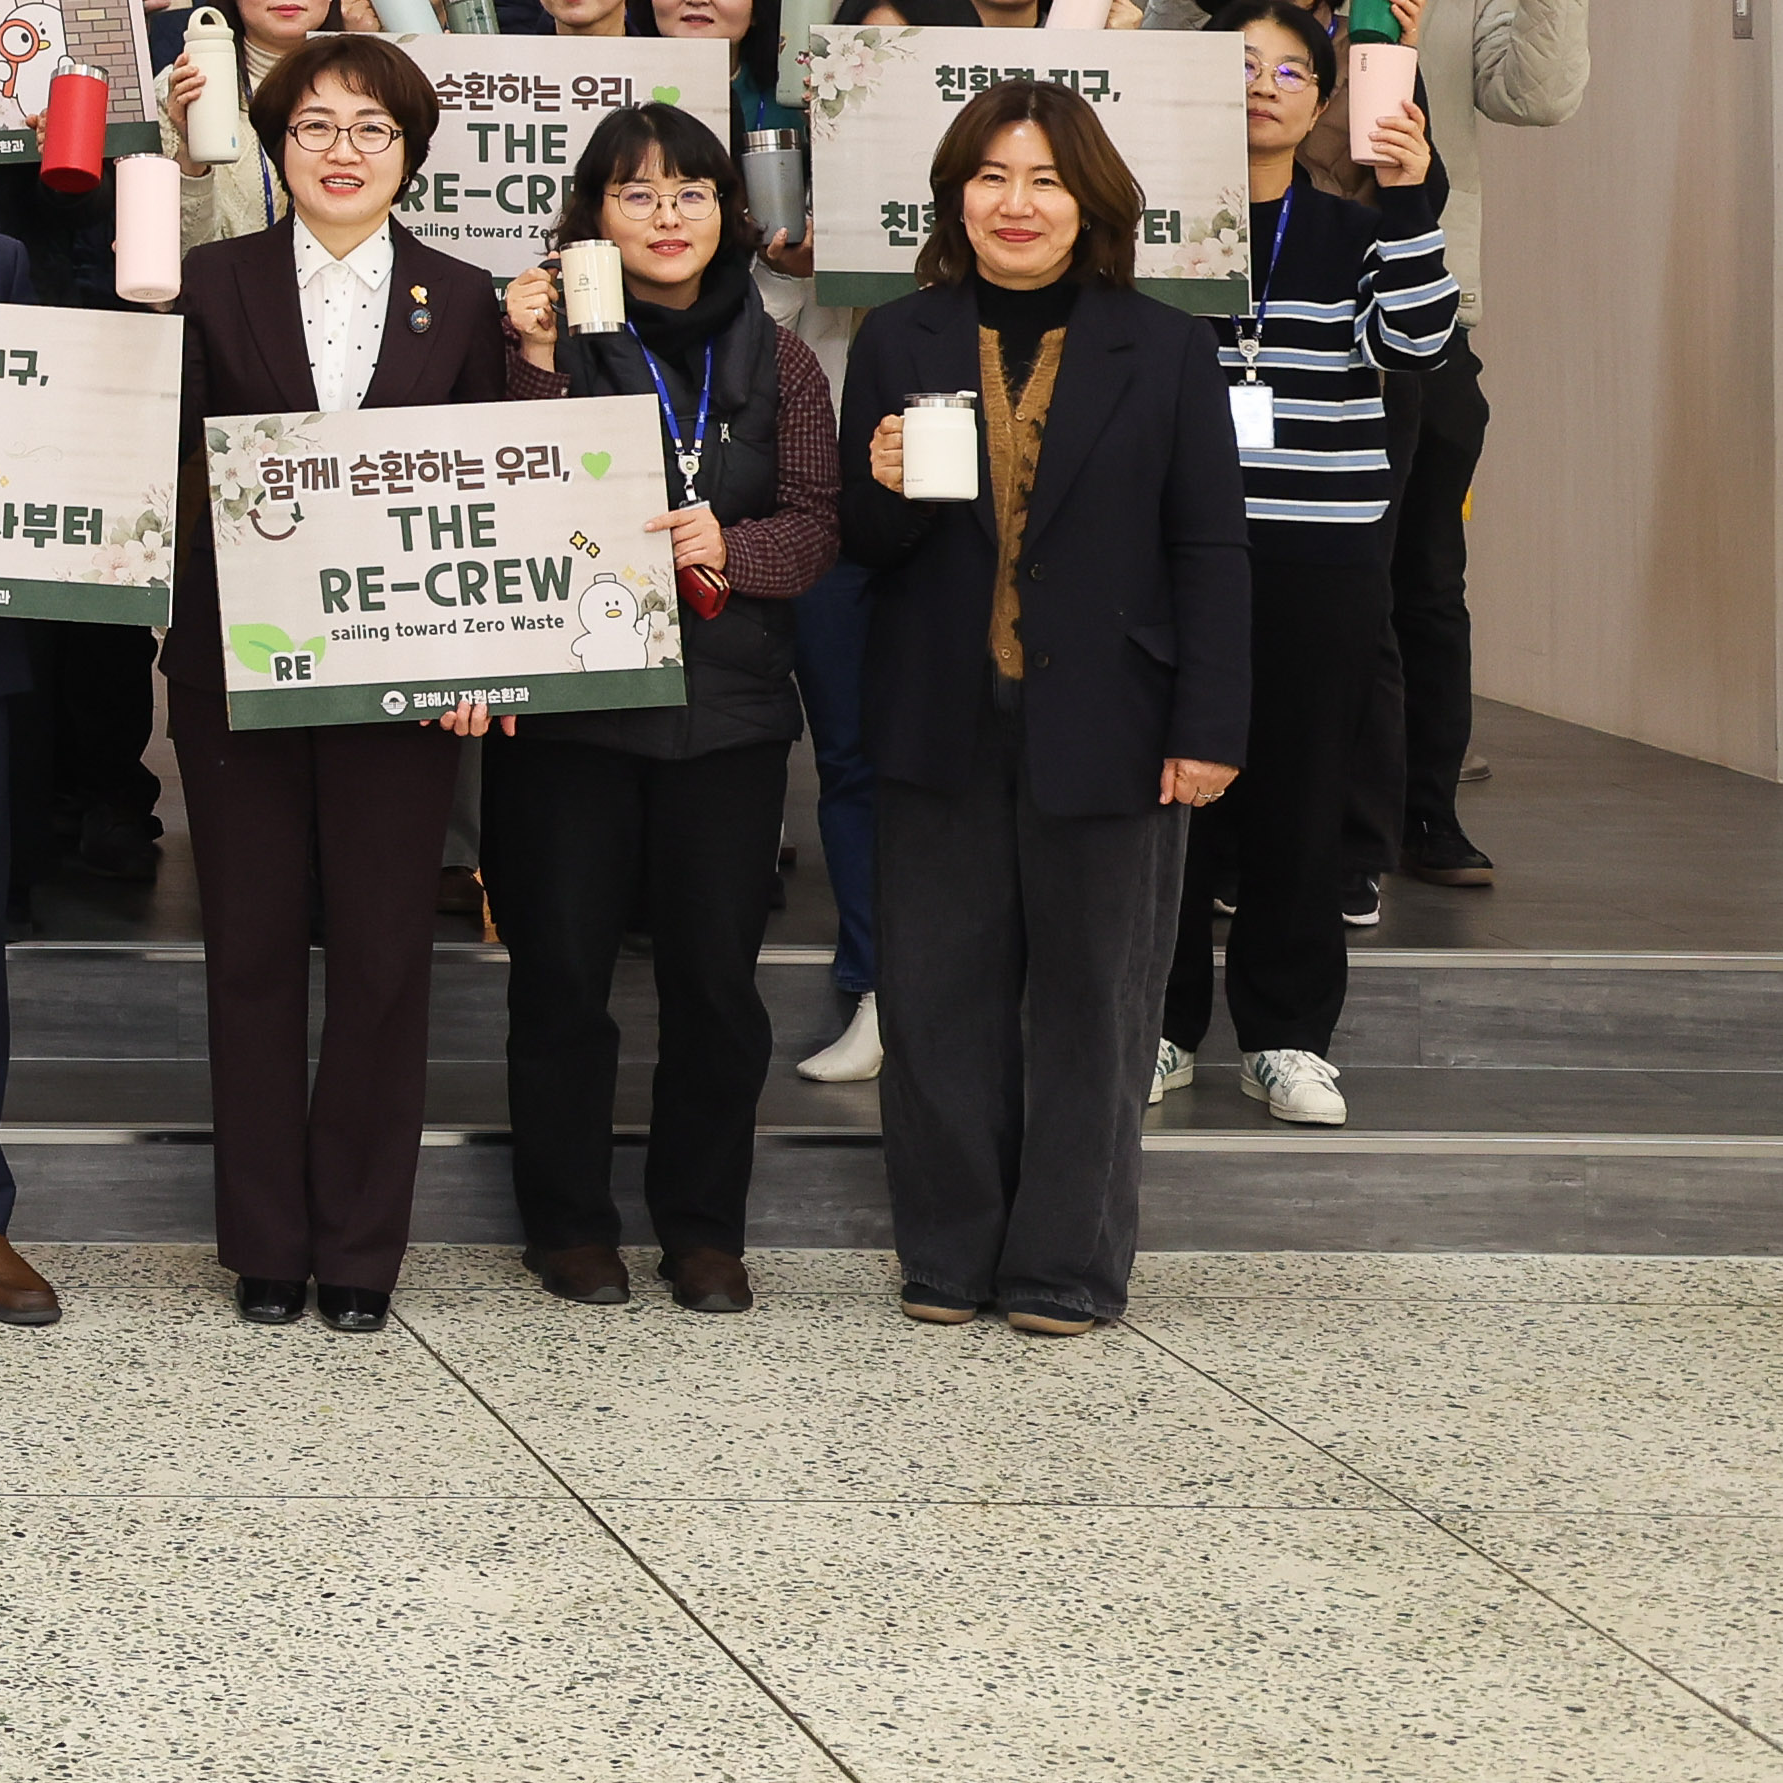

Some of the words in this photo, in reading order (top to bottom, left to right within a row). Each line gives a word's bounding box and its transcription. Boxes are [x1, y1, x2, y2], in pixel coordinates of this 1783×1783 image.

[436, 72, 561, 112] 순환하는
[467, 123, 568, 164] THE
[406, 224, 460, 240] sailing
[465, 224, 523, 239] toward
[259, 456, 340, 501] 함께
[349, 449, 485, 497] 순환하는
[495, 445, 571, 486] 우리,
[387, 502, 498, 552] THE
[319, 555, 573, 614] RE-CREW
[331, 624, 390, 642] sailing
[395, 619, 457, 639] toward
[463, 617, 505, 635] Zero
[511, 614, 565, 632] Waste
[274, 653, 313, 683] RE
[413, 692, 456, 709] 김해시
[459, 686, 530, 706] 자원순환과
